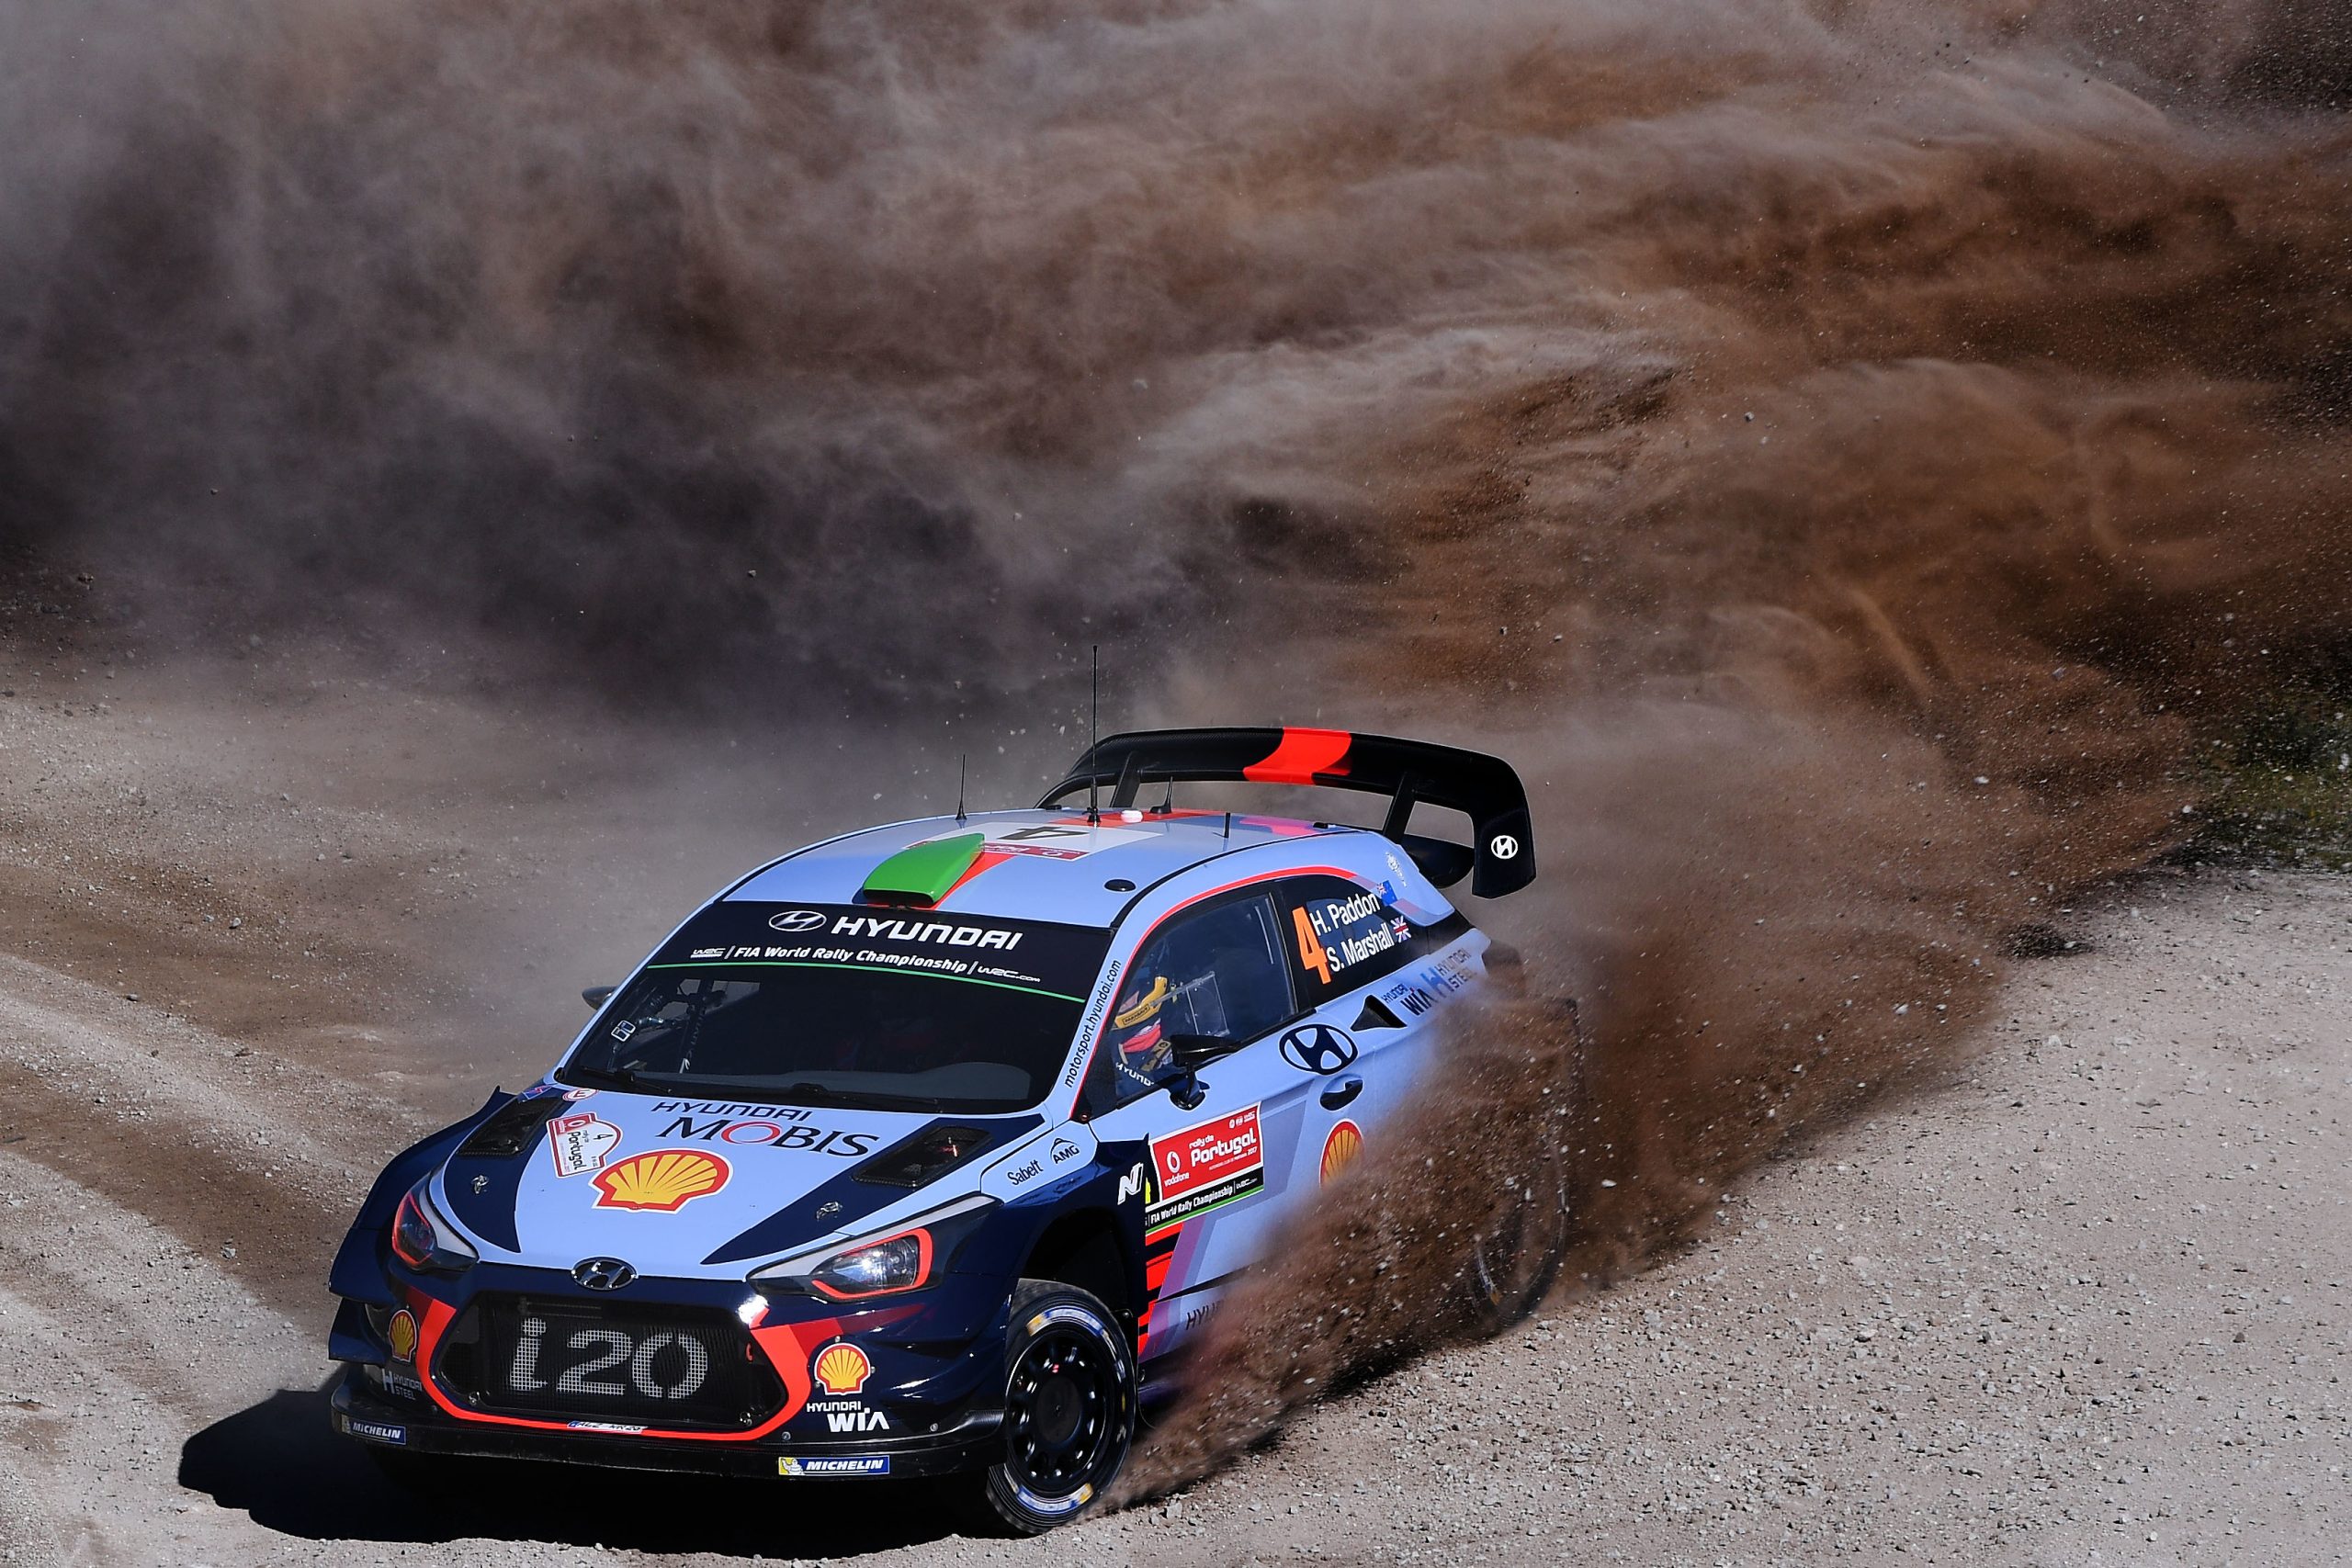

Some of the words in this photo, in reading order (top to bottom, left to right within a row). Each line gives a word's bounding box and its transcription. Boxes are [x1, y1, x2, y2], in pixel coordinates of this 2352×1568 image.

[1309, 908, 1331, 936] H.
[1327, 892, 1381, 930] Paddon
[831, 916, 1023, 951] HYUNDAI
[1292, 906, 1332, 985] 4
[1326, 946, 1345, 973] S.
[1340, 922, 1396, 966] Marshall
[734, 946, 760, 958] FIA
[764, 946, 811, 959] World
[812, 947, 854, 962] Rally
[855, 950, 968, 974] Championship
[1064, 959, 1122, 1089] motorsport.hyundai.com
[1115, 1062, 1155, 1087] HYUND
[651, 1101, 813, 1122] HYUNDAI
[567, 1131, 587, 1170] Portugal
[655, 1116, 880, 1157] MOBIS
[1191, 1127, 1257, 1167] Portugal
[1052, 1145, 1080, 1164] AMG
[1007, 1159, 1044, 1186] Sabelt
[1164, 1172, 1190, 1187] vodafone
[1150, 1214, 1160, 1224] FIA
[1160, 1205, 1177, 1220] World
[1178, 1201, 1193, 1213] Rally
[1193, 1185, 1233, 1204] Championship
[510, 1317, 707, 1399] i20
[393, 1373, 423, 1391] HYUNDAI
[395, 1385, 416, 1400] STEEL
[807, 1401, 861, 1412] HYUNDAI
[353, 1422, 401, 1438] MICHELIN
[806, 1460, 884, 1471] MICHELIN
